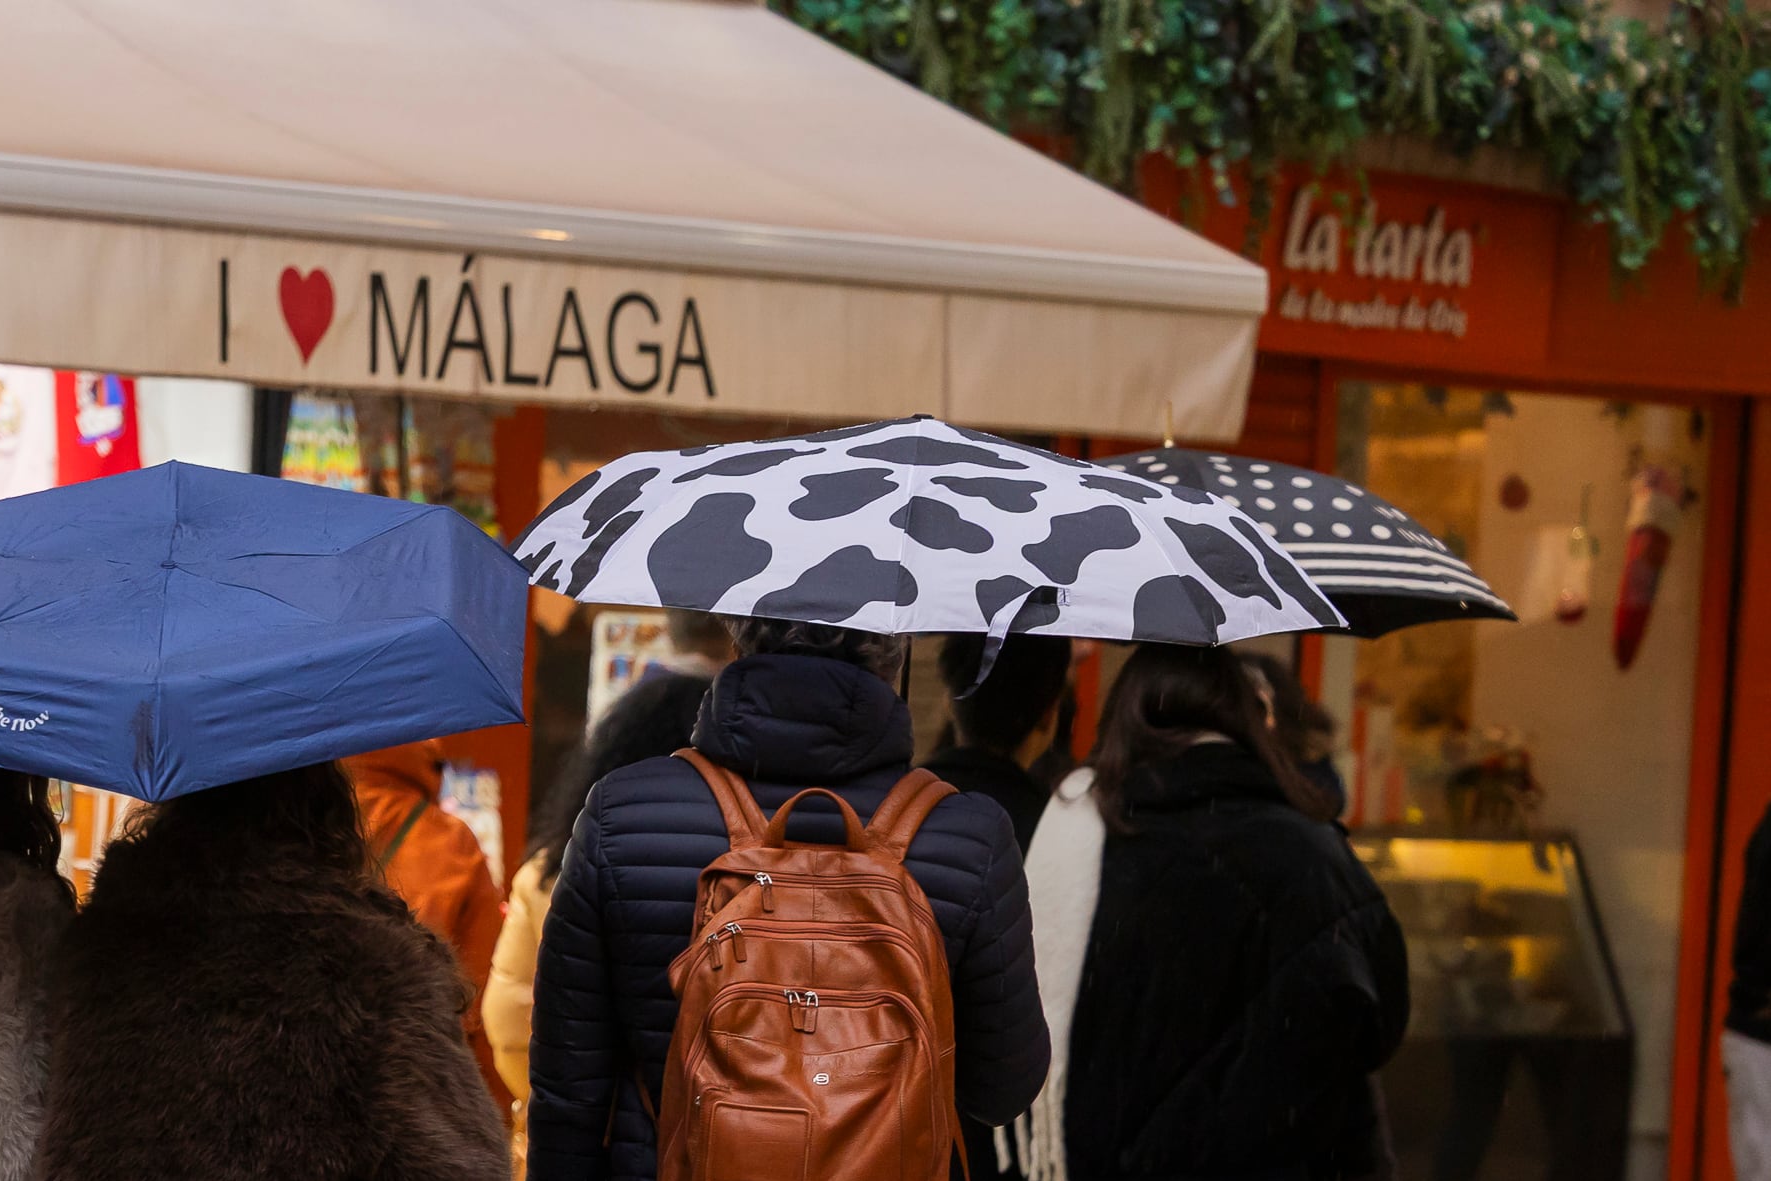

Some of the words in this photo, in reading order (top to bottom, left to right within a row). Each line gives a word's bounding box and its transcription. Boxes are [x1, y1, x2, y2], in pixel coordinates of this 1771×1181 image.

[1283, 184, 1339, 274] La
[218, 258, 229, 364] I
[369, 253, 718, 398] MÁLAGA
[10, 709, 50, 732] flow
